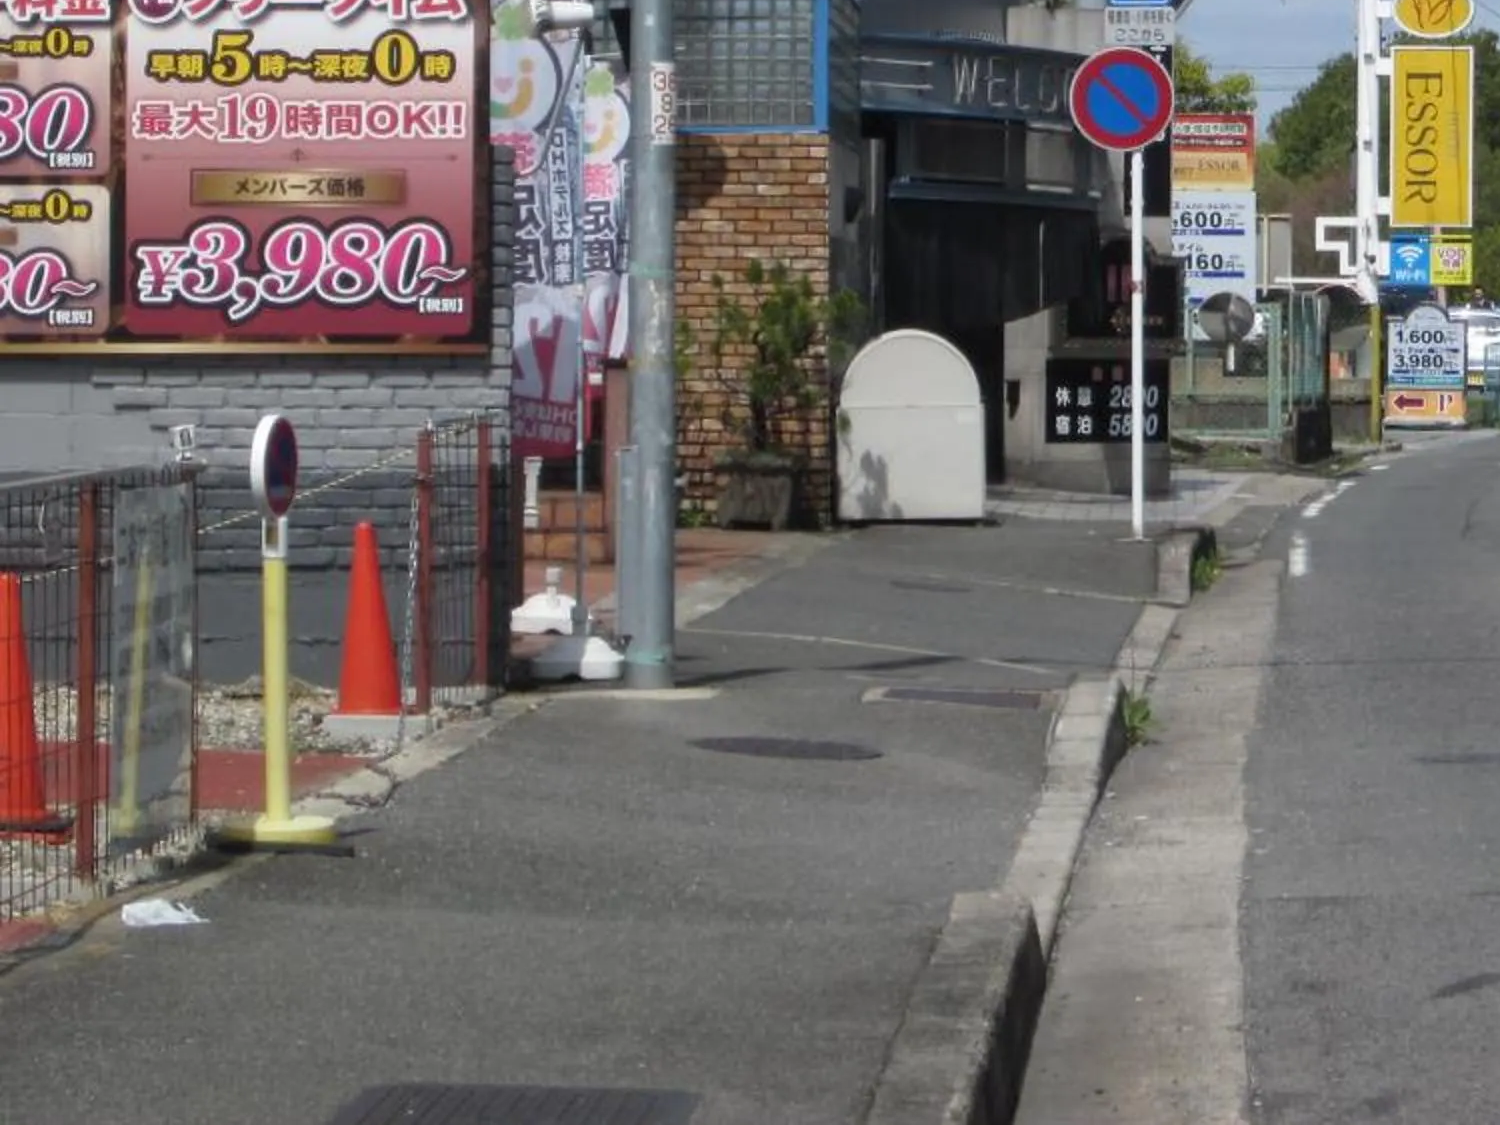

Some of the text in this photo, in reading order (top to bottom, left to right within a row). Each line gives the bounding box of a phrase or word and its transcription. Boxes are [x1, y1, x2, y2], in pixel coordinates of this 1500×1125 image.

[1114, 27, 1166, 43] ここから
[1405, 71, 1443, 204] ESSOR
[234, 176, 367, 198] メンバーズ価格
[1109, 386, 1159, 407] 280
[1438, 393, 1454, 412] P
[1055, 415, 1159, 436] 宿泊 580
